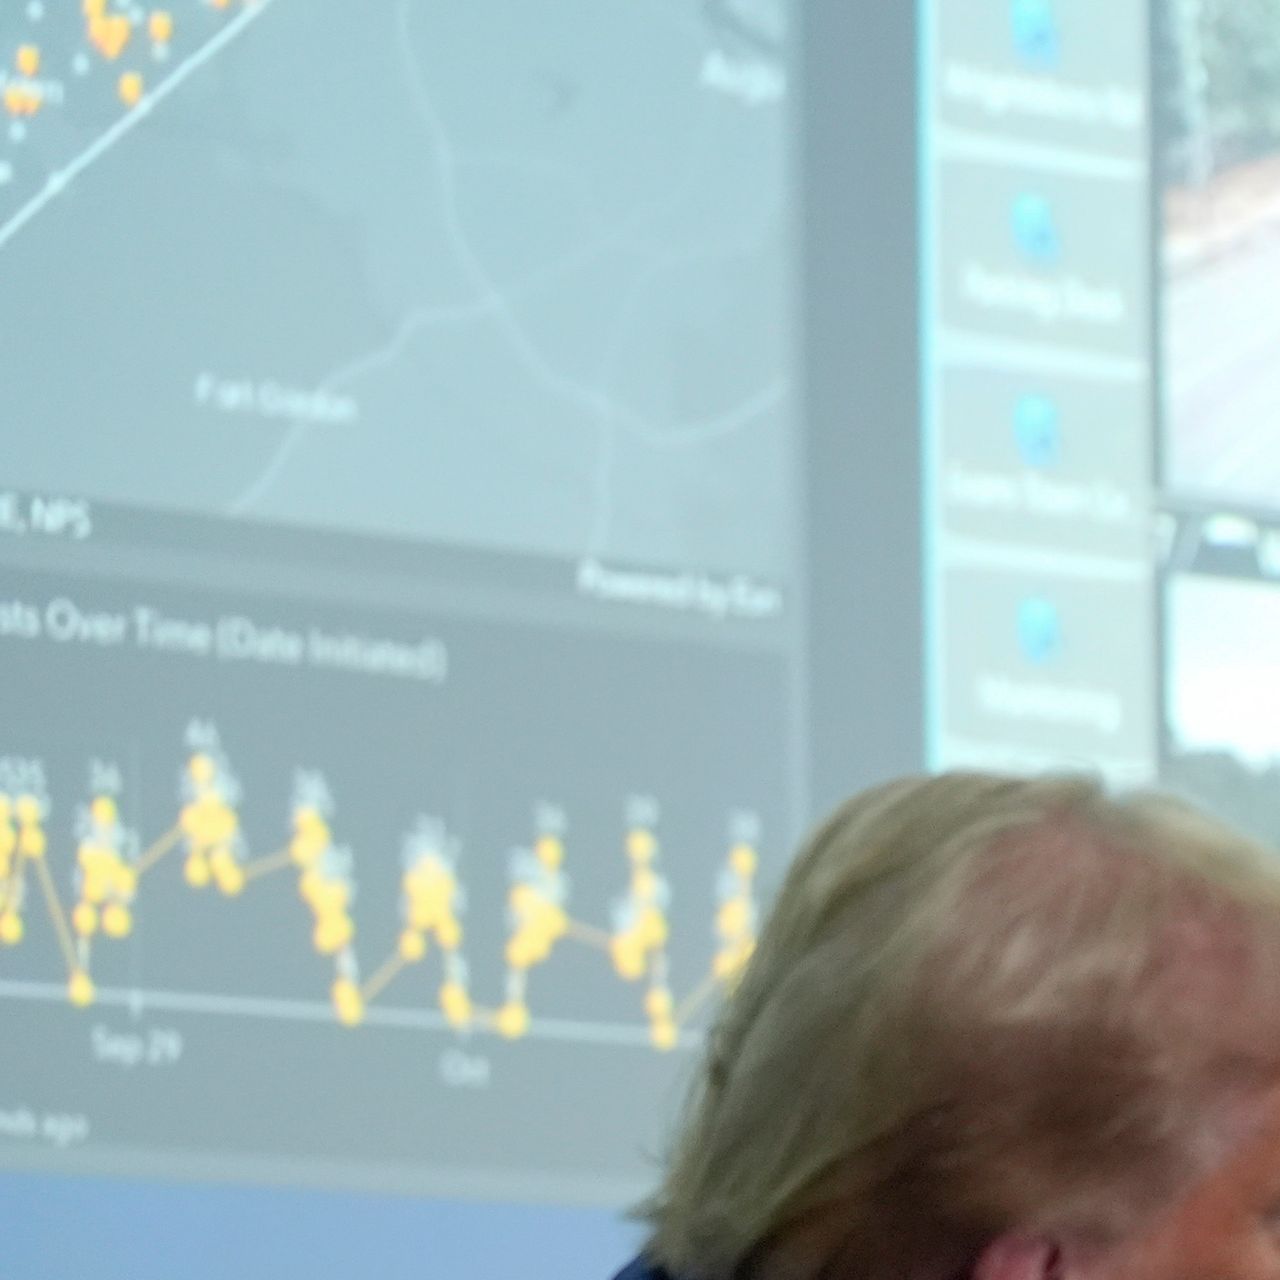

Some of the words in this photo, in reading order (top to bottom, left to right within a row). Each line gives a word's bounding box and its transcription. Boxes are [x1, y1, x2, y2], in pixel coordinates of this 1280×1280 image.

[45, 599, 126, 645] Over
[133, 606, 212, 655] Time
[215, 615, 302, 663] (Date
[92, 1024, 142, 1068] Sep
[440, 1048, 491, 1087] Oct
